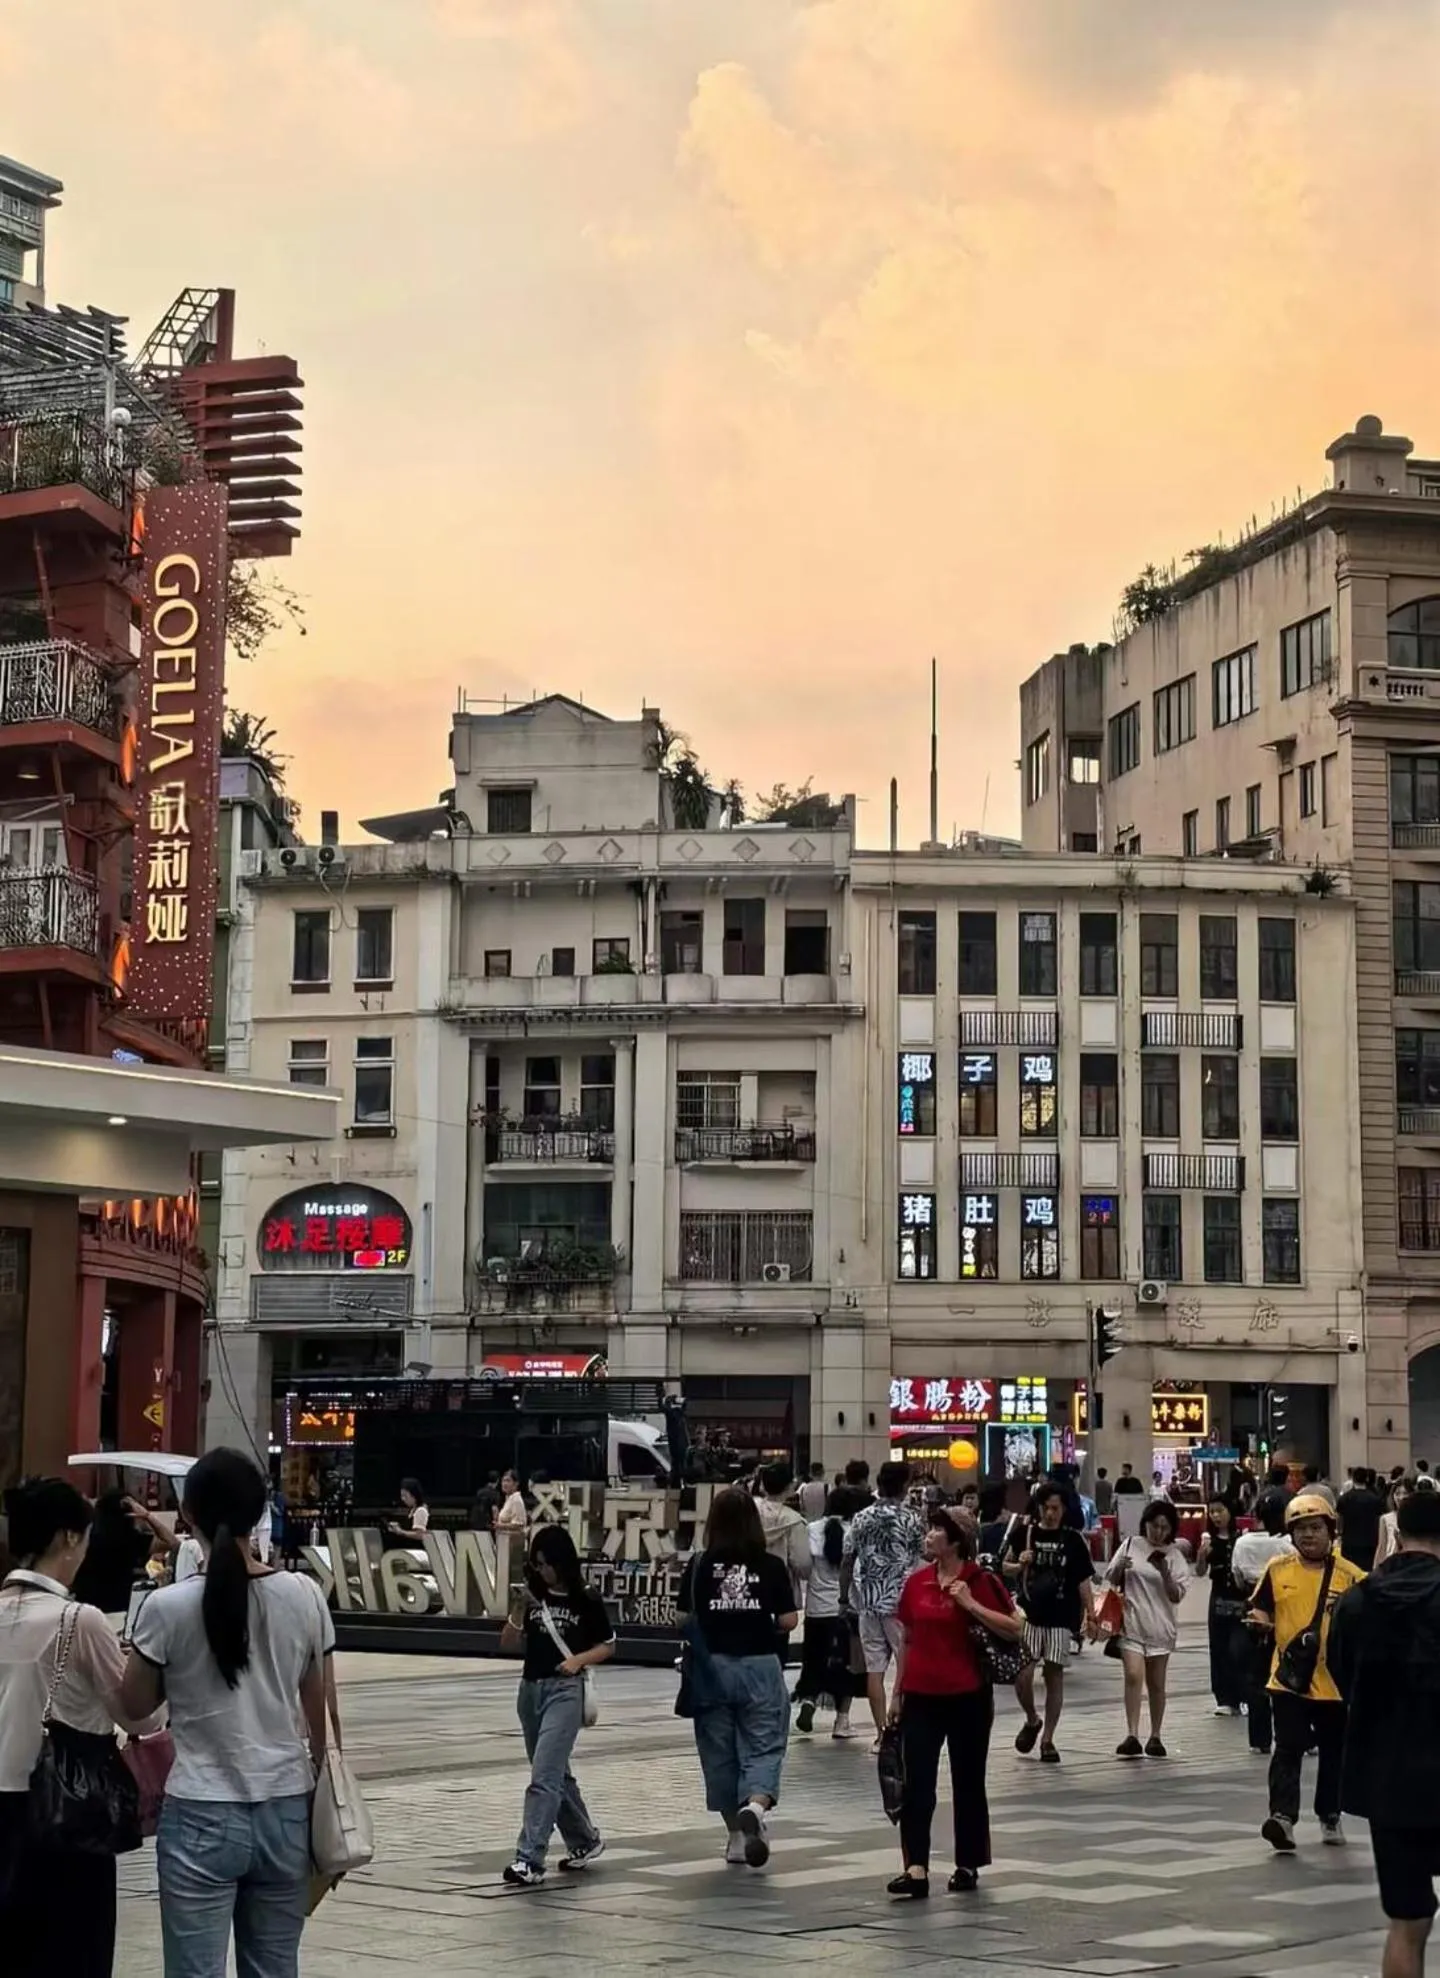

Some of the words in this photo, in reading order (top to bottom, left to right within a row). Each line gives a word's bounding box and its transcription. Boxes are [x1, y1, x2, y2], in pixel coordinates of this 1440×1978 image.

[151, 553, 200, 772] GOELIA
[146, 781, 190, 943] 歌莉娅
[901, 1053, 1053, 1082] 椰子鸡
[304, 1202, 368, 1216] Massage
[903, 1195, 1054, 1226] 猪肚鸡
[266, 1218, 404, 1251] 沐足按摩
[387, 1250, 406, 1263] 2F
